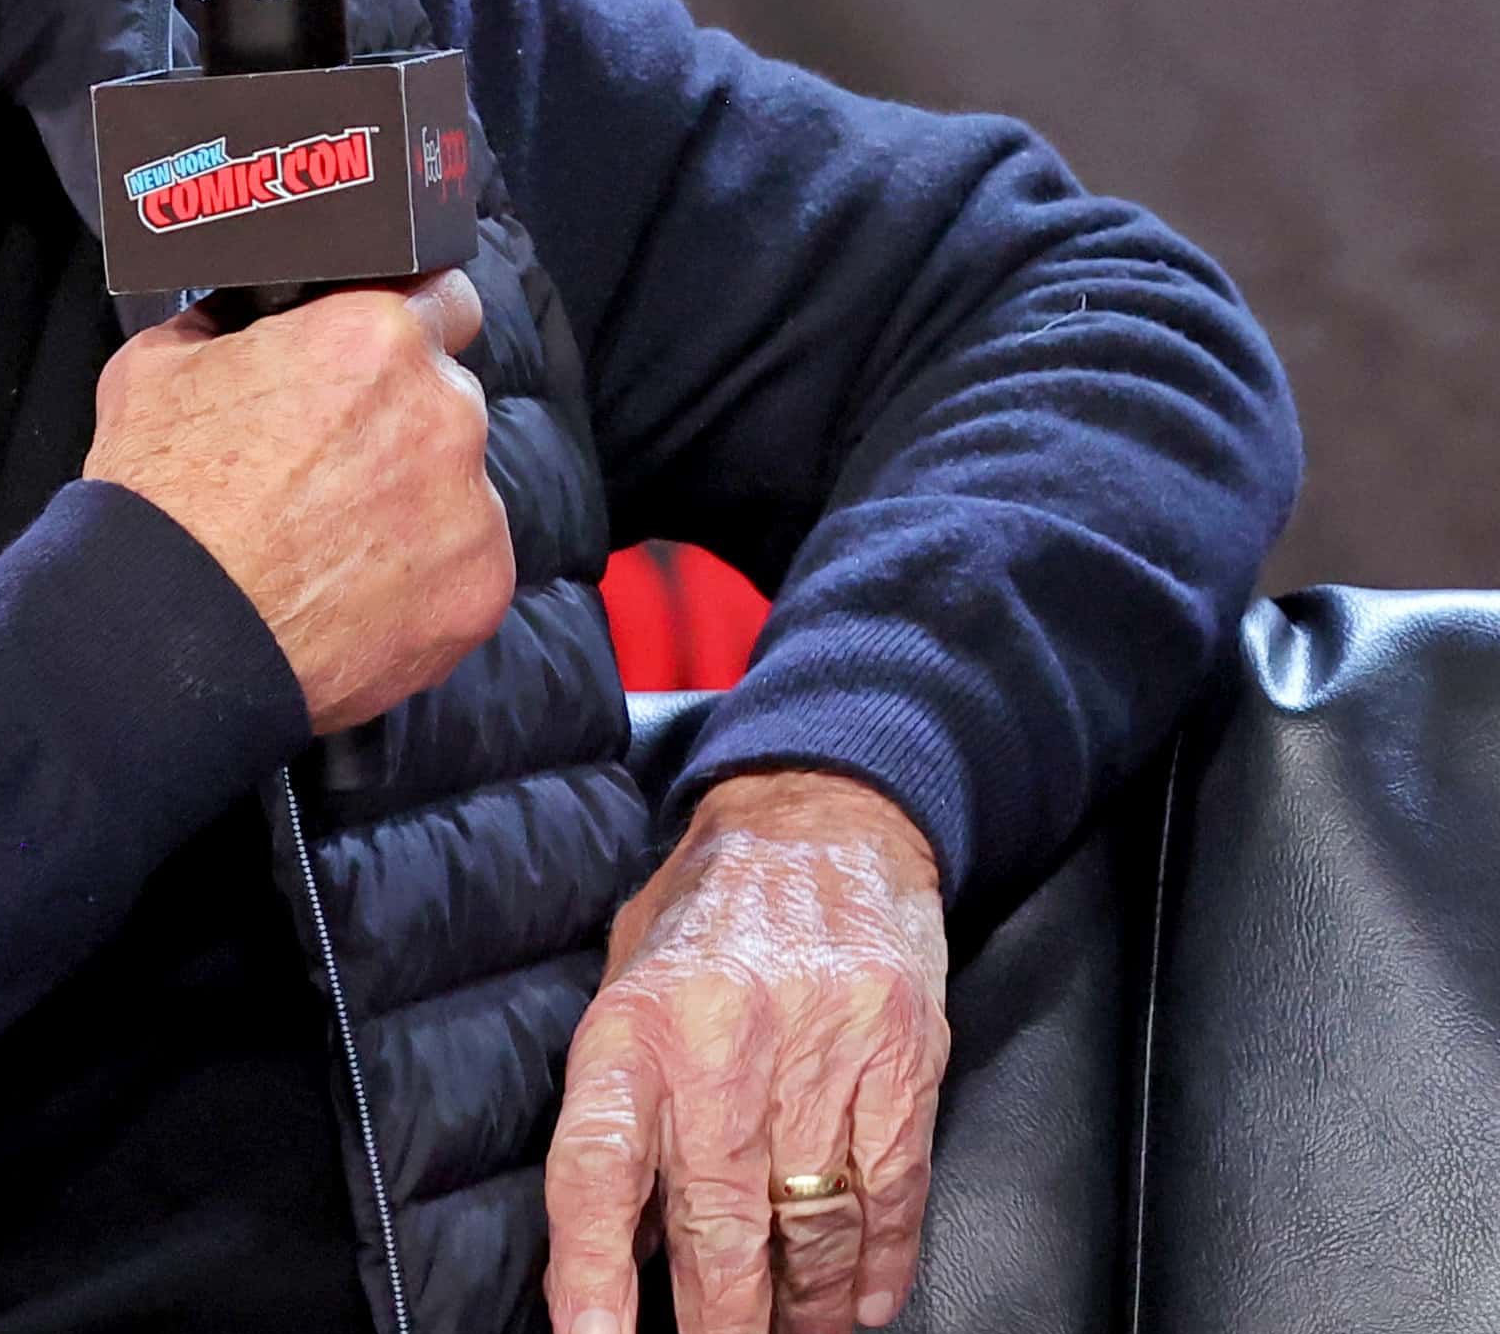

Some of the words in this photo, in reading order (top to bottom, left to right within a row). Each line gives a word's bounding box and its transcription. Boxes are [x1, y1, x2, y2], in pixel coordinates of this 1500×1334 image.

[129, 162, 173, 195] NEW
[173, 143, 226, 177] YORK
[144, 155, 276, 228] COMIC
[283, 132, 368, 195] CON
